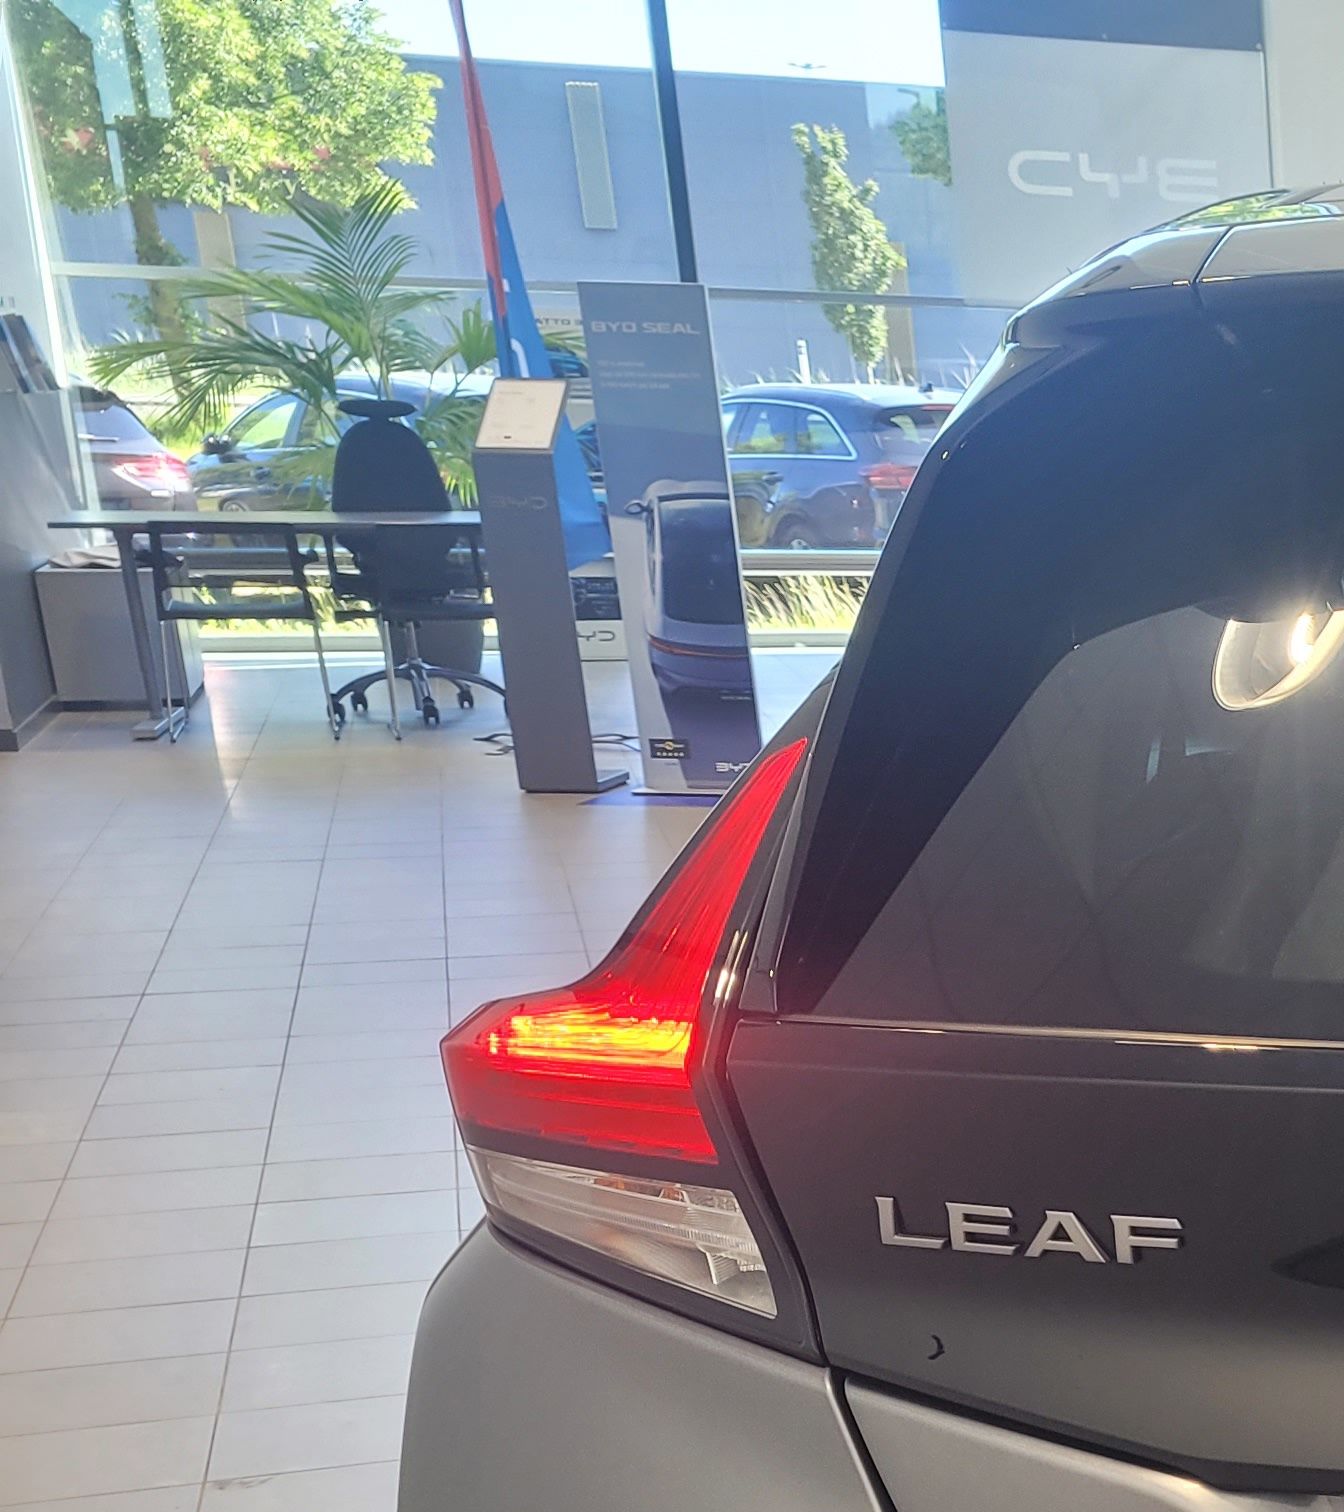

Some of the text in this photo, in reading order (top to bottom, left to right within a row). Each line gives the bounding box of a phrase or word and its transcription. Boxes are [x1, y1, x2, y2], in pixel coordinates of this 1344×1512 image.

[591, 321, 700, 335] BYD SEAL
[577, 630, 615, 642] YD
[875, 1196, 1183, 1265] LEAF
